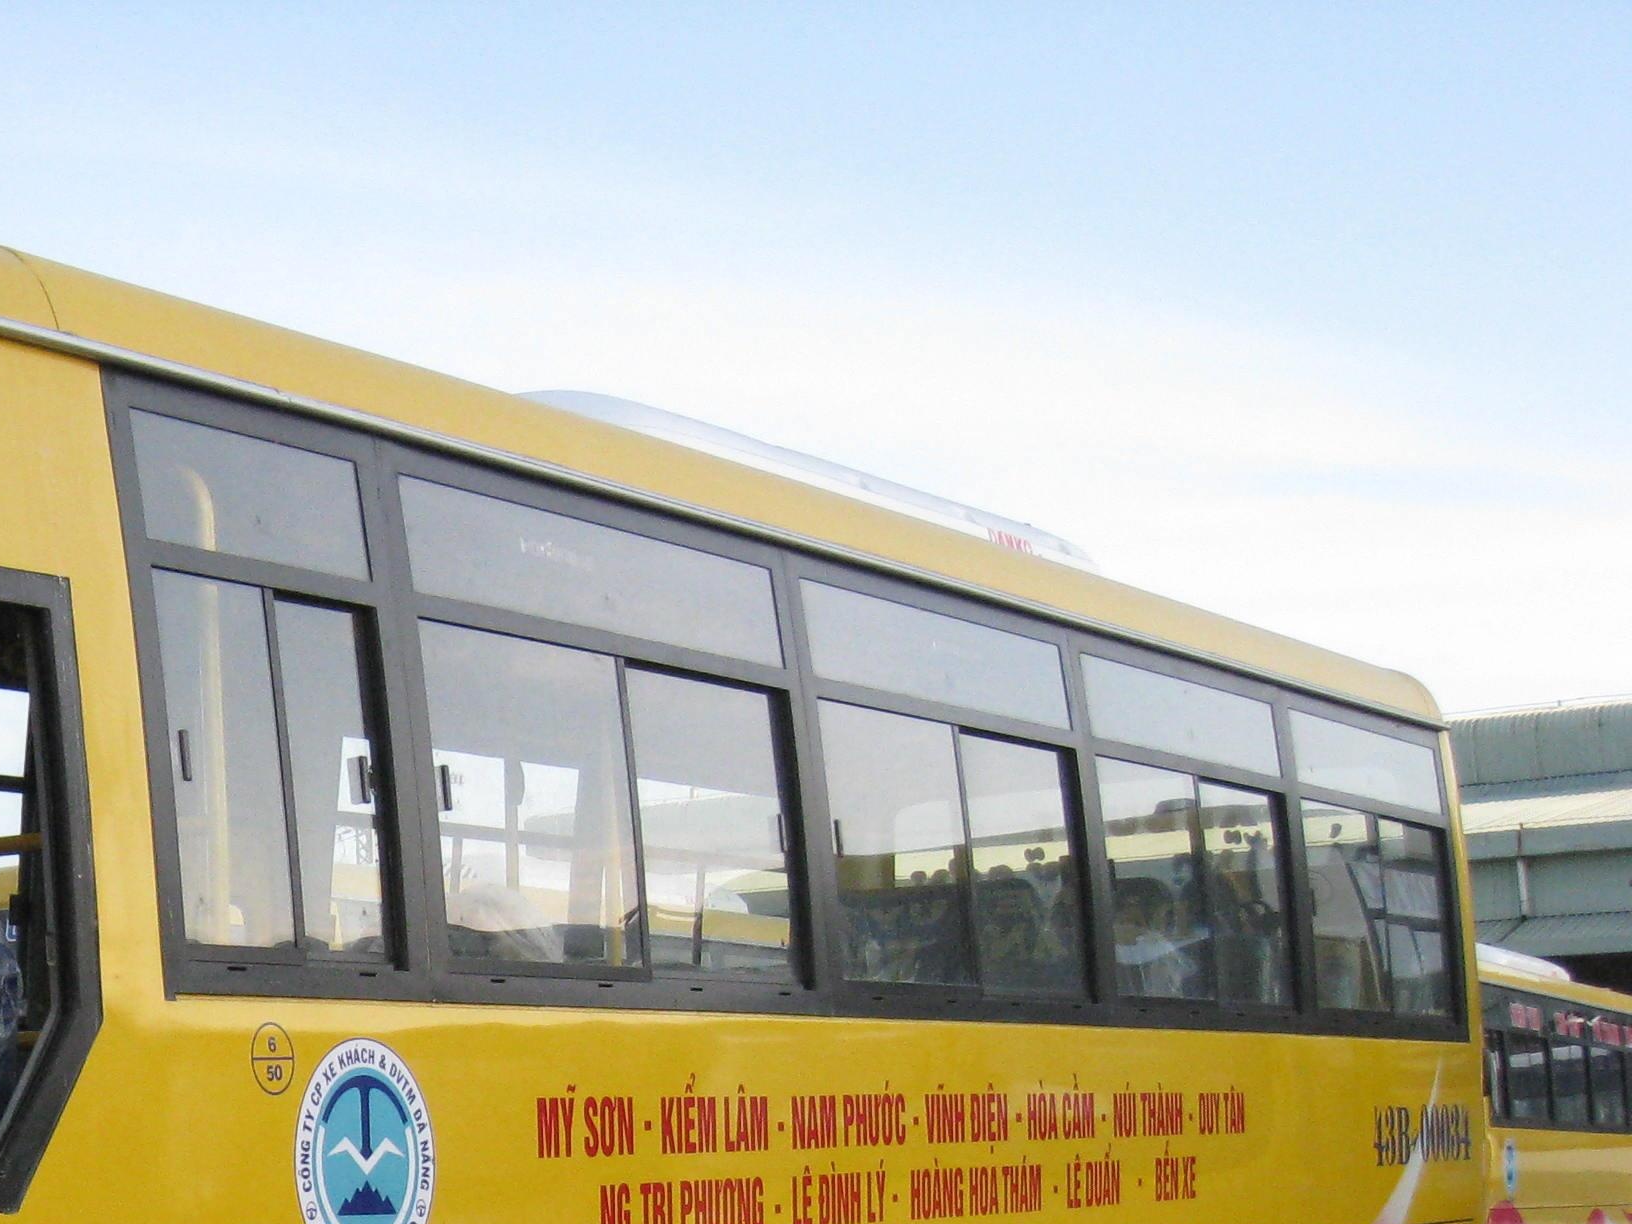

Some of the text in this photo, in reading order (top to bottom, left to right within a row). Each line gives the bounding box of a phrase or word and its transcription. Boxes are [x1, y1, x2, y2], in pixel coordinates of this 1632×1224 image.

[268, 1036, 277, 1053] 6
[337, 1043, 375, 1070] KHÁCH
[267, 1064, 283, 1081] 50
[322, 1062, 337, 1086] XE
[378, 1054, 387, 1070] &
[310, 1082, 323, 1106] CP
[389, 1063, 416, 1106] DVTM
[302, 1109, 315, 1133] TY
[537, 1084, 576, 1158] MỸ
[583, 1096, 634, 1157] SƠN
[661, 1072, 717, 1154] KIỂM
[723, 1083, 769, 1152] LÂM
[791, 1095, 838, 1150] NAM
[843, 1080, 906, 1146] PHƯỚC
[924, 1083, 965, 1143] VĨNH
[1027, 1080, 1058, 1140] HÒA
[1113, 1082, 1137, 1138] NÚI
[1140, 1082, 1183, 1136] THÀNH
[1198, 1092, 1220, 1134] DUY
[298, 1140, 312, 1192] CÔNG
[866, 1159, 886, 1223] LÝ
[911, 1158, 964, 1220] HOÀNG
[1002, 1155, 1042, 1214] THÁM
[1066, 1153, 1082, 1208] LÊ
[1182, 1156, 1196, 1199] XE
